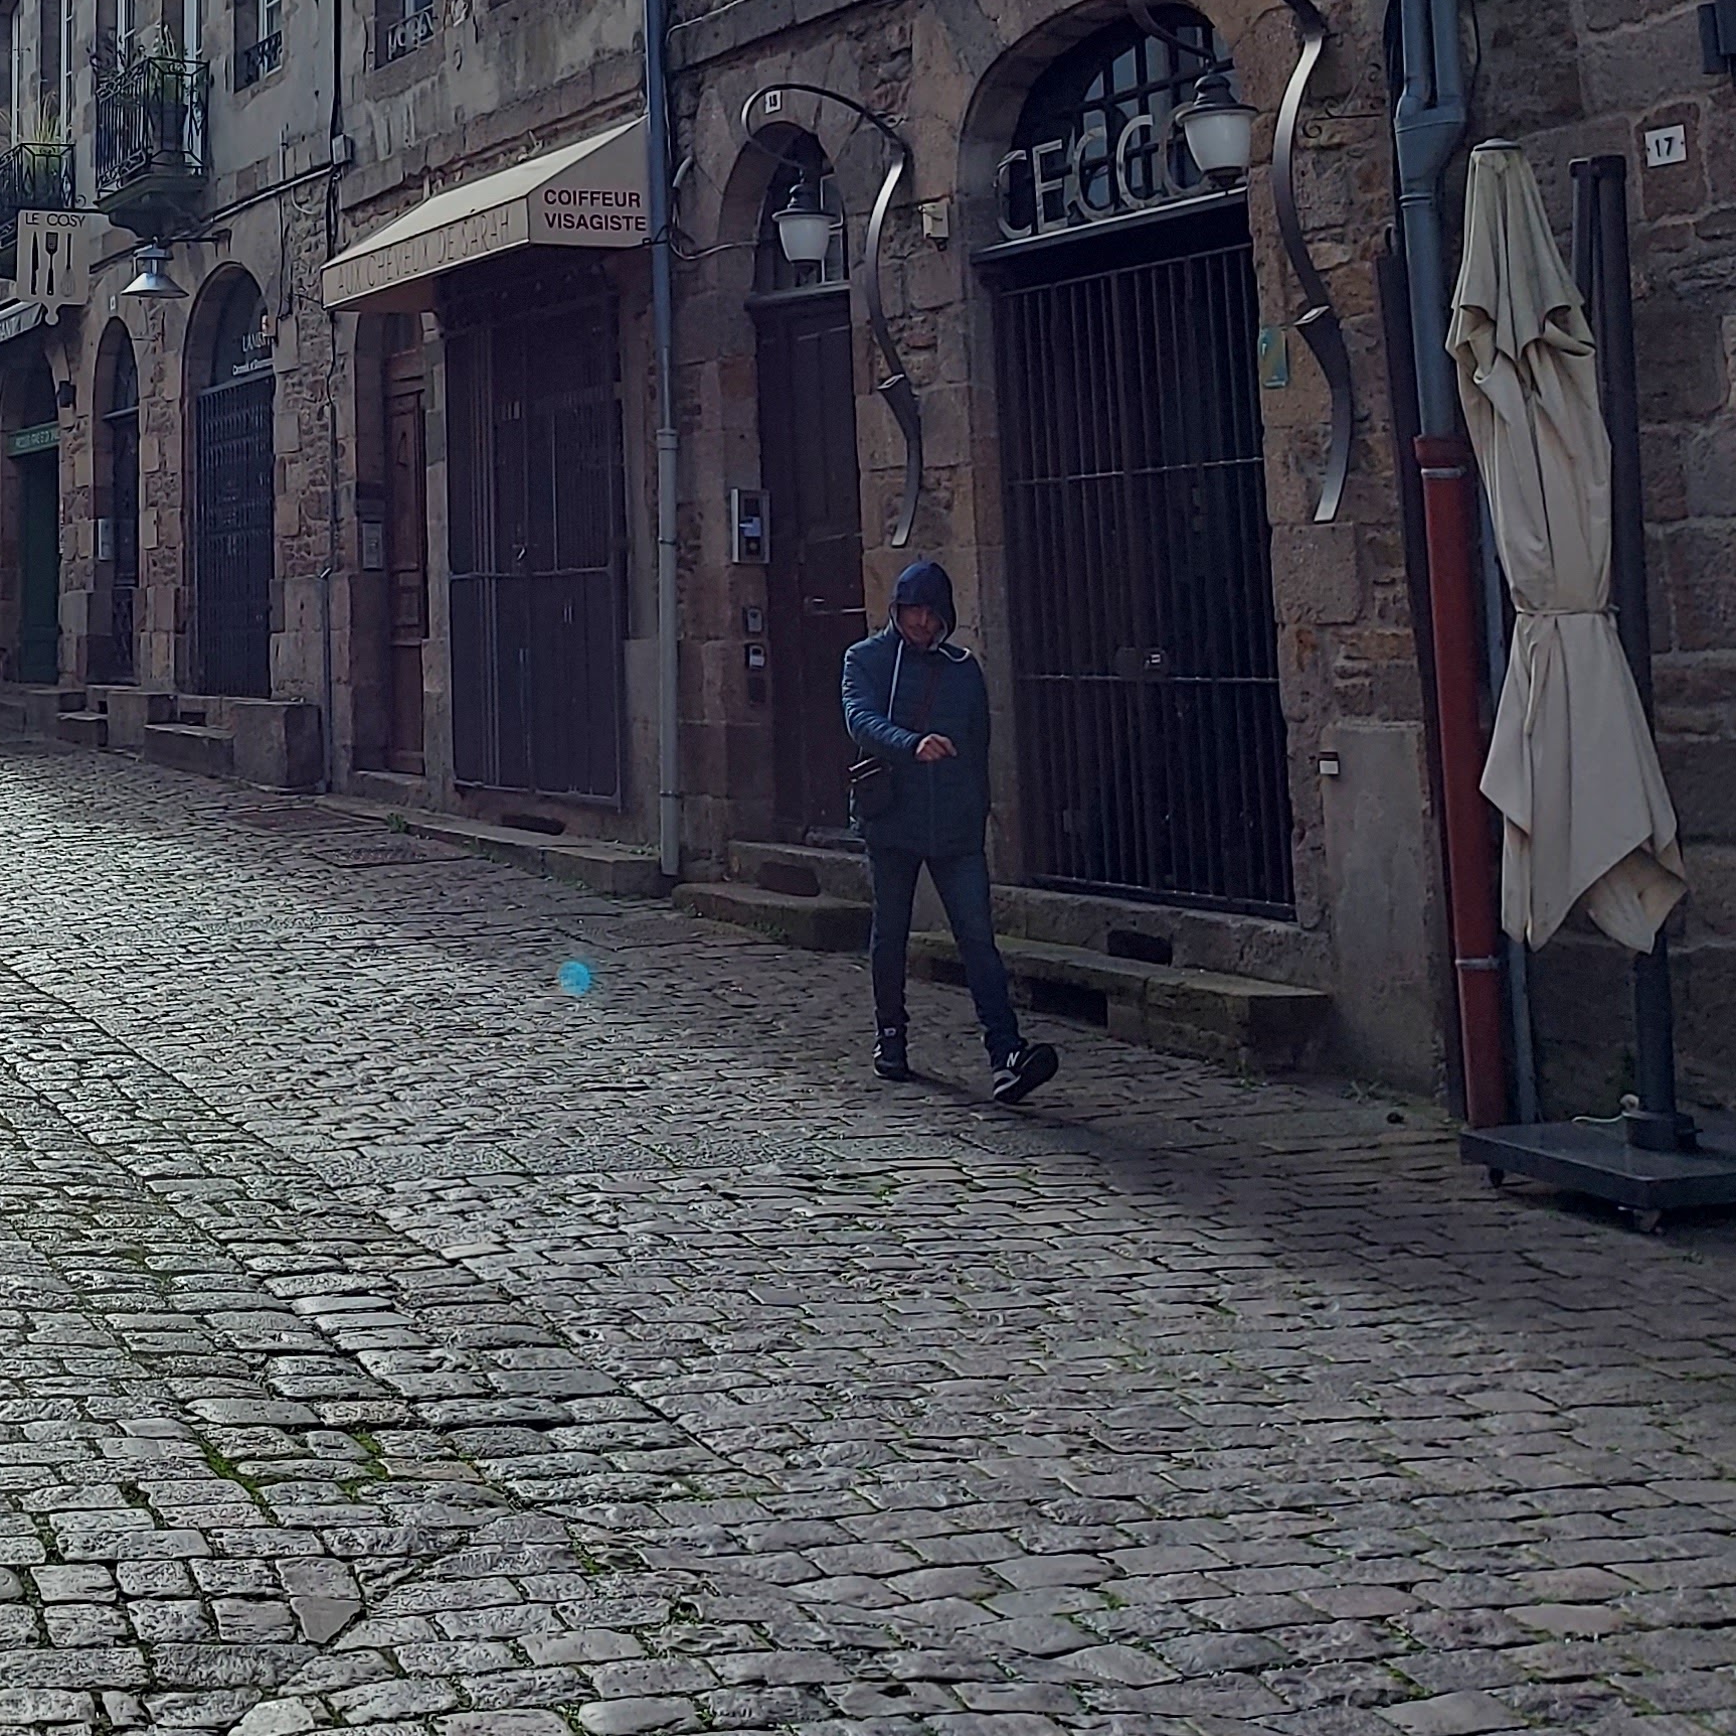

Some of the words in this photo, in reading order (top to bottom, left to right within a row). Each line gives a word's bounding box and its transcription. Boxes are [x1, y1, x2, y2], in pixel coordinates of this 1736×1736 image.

[1655, 136, 1675, 158] 17
[543, 189, 641, 208] COIFFEUR
[25, 212, 40, 226] LE
[46, 213, 86, 227] COSY
[543, 212, 648, 232] VISAGISTE
[337, 261, 362, 298] AUX
[367, 238, 436, 288] CHEVEUX
[438, 225, 455, 265] DE
[461, 207, 510, 258] SARAH
